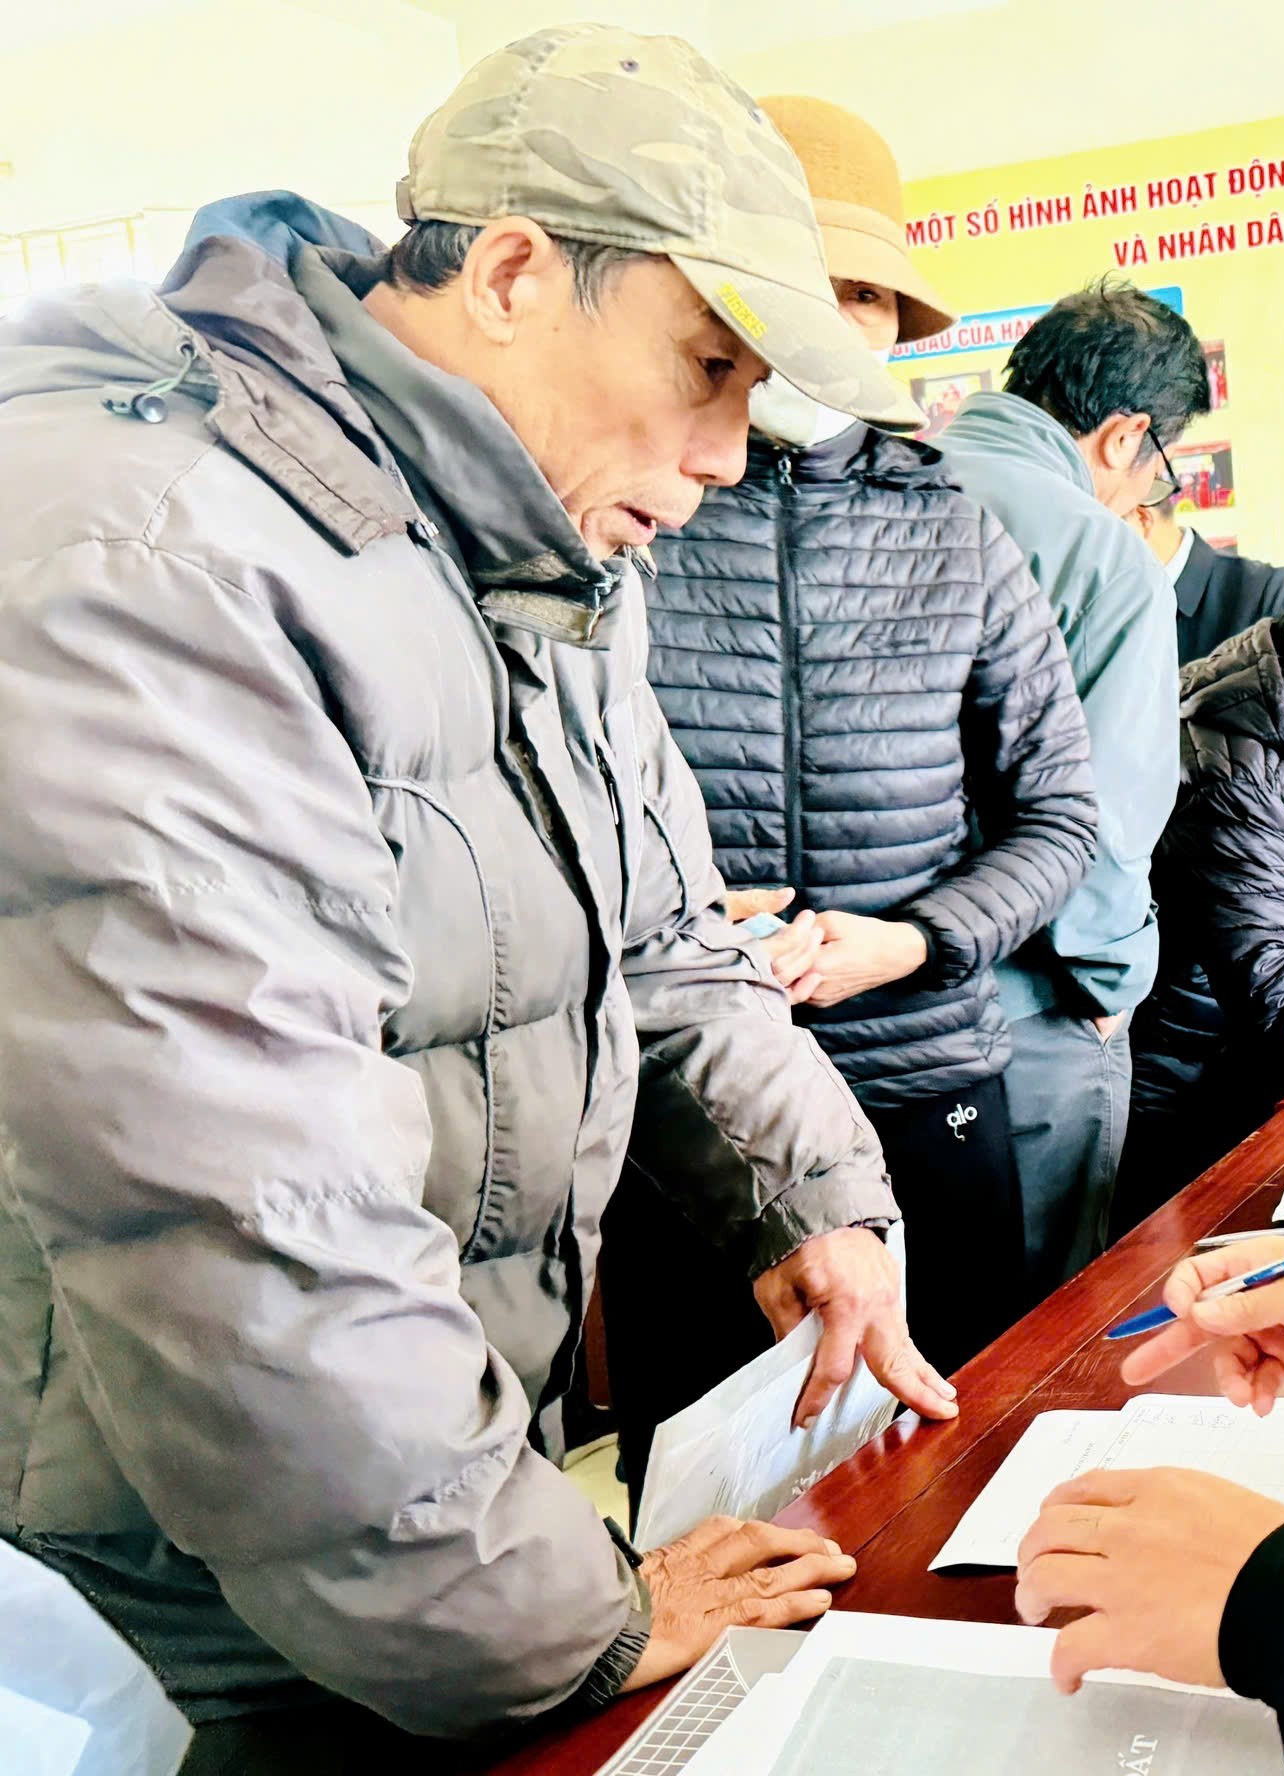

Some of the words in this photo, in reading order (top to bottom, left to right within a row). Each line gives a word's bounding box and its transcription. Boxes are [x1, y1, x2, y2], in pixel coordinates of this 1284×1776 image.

[905, 214, 956, 249] MỘT
[966, 198, 1000, 237] SỐ
[1009, 197, 1072, 230] HÌNH
[1082, 183, 1138, 219] ẢNH
[1147, 172, 1217, 208] HOẠT
[1114, 239, 1148, 267] VÀ
[1158, 224, 1236, 261] NHÂN
[957, 322, 996, 346] CỦA
[1118, 1734, 1159, 1776] ẤT
